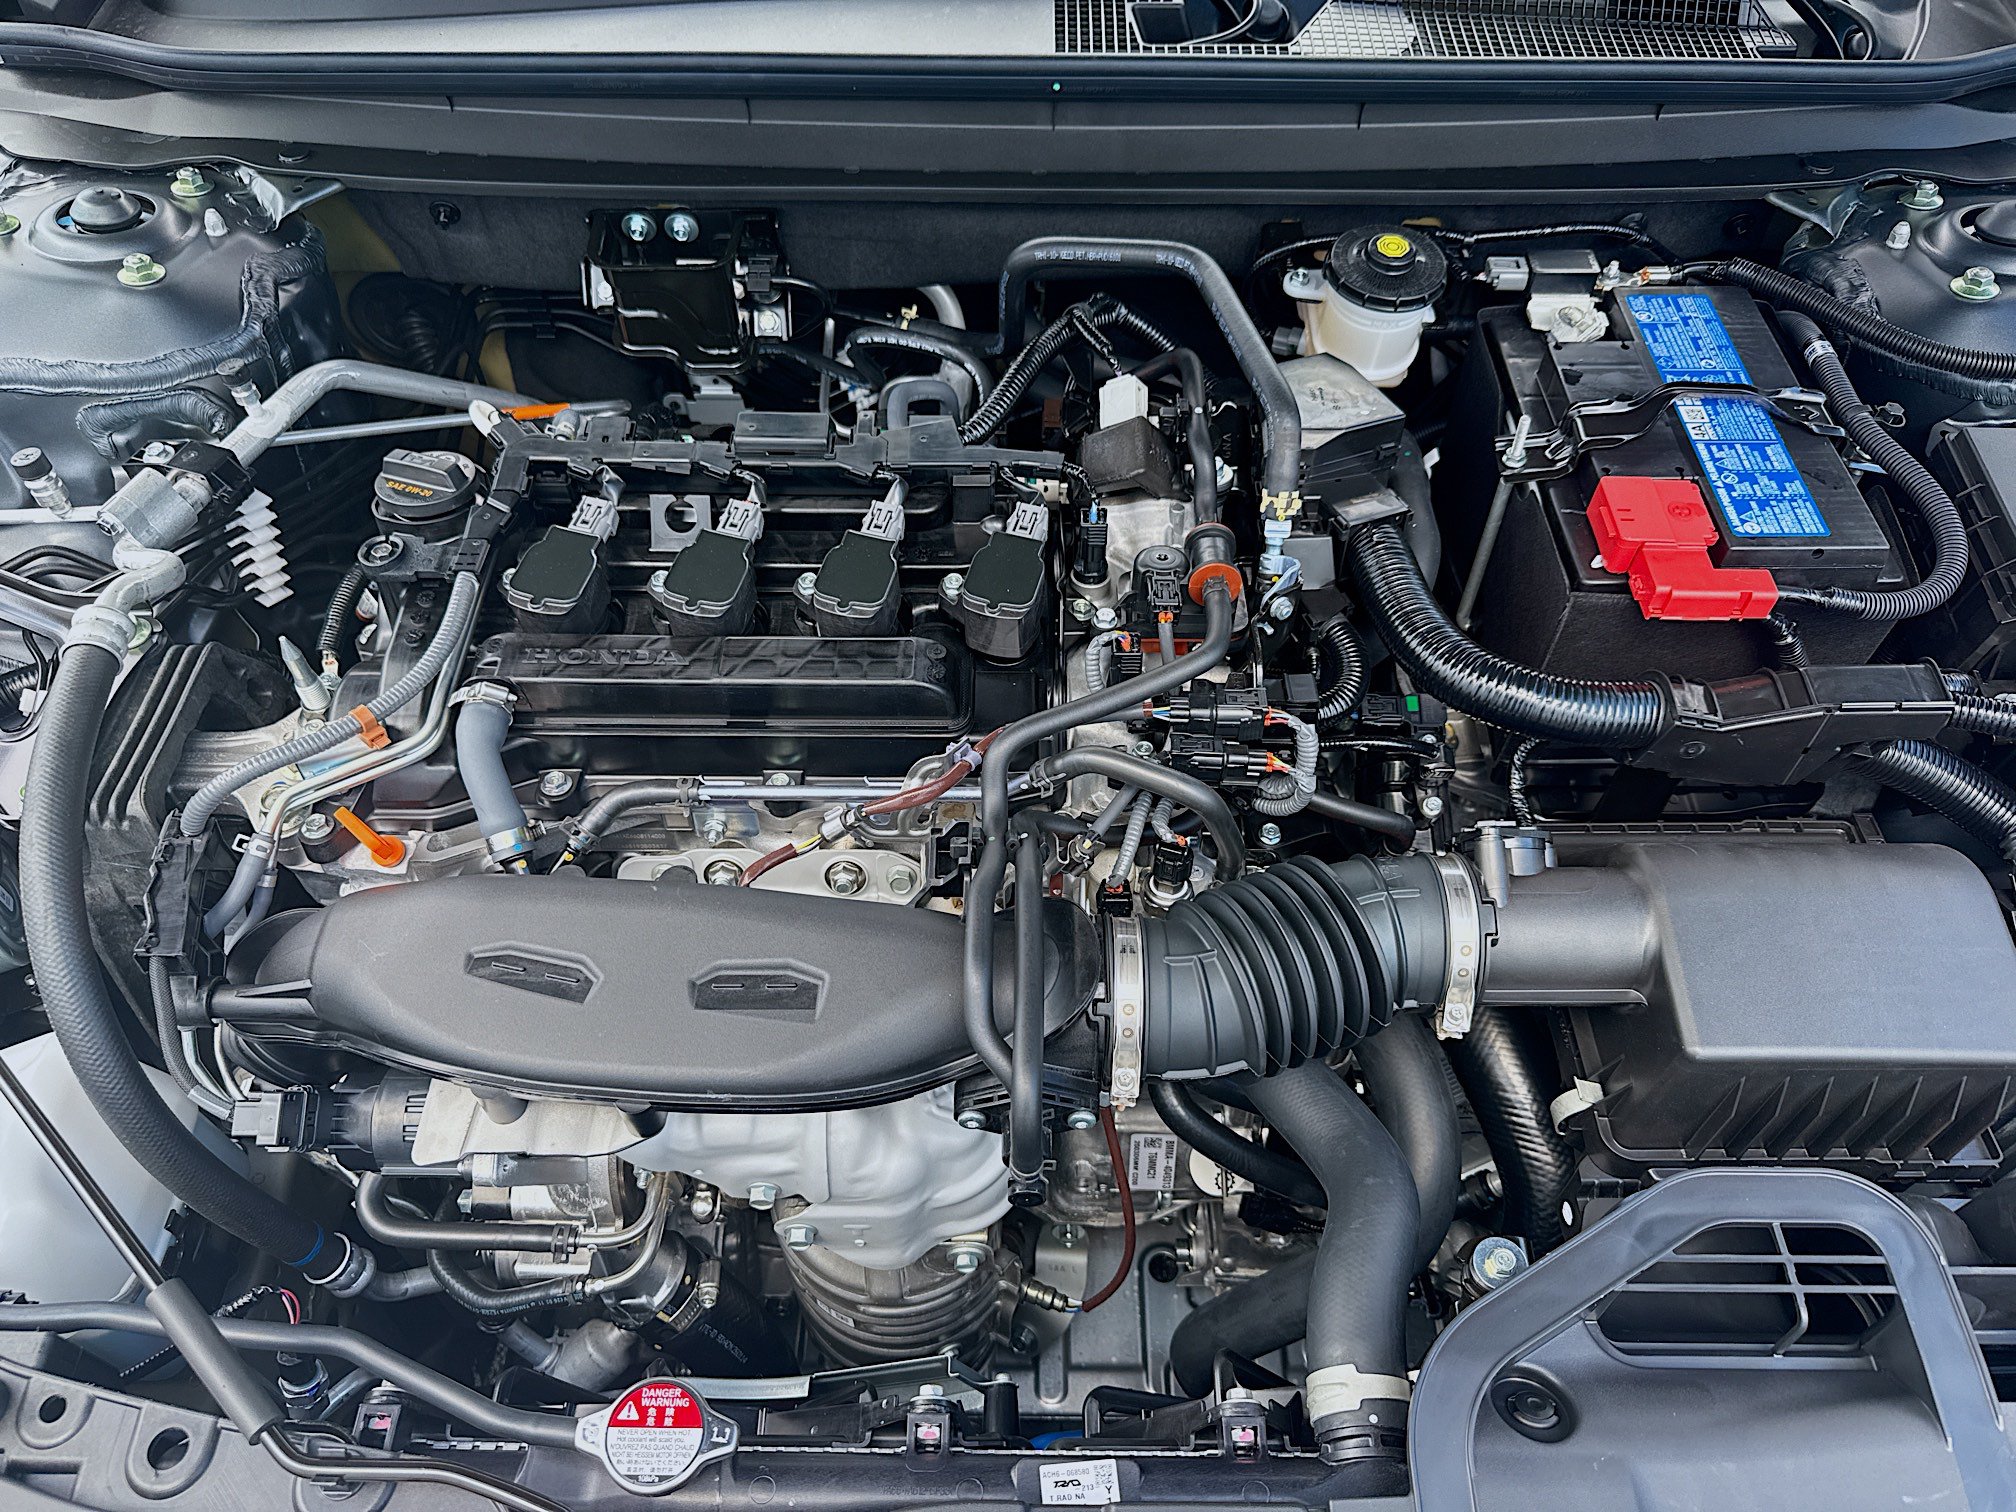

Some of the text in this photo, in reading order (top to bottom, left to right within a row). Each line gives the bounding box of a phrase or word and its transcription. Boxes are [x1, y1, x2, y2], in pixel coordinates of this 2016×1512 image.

[386, 481, 406, 491] SAE
[405, 485, 433, 497] 0W-20
[522, 648, 689, 666] HONDA
[642, 1388, 682, 1397] DANGER
[641, 1398, 690, 1407] WARNUNG
[610, 1443, 639, 1451] N'OUVREZ
[1105, 1485, 1112, 1494] Y
